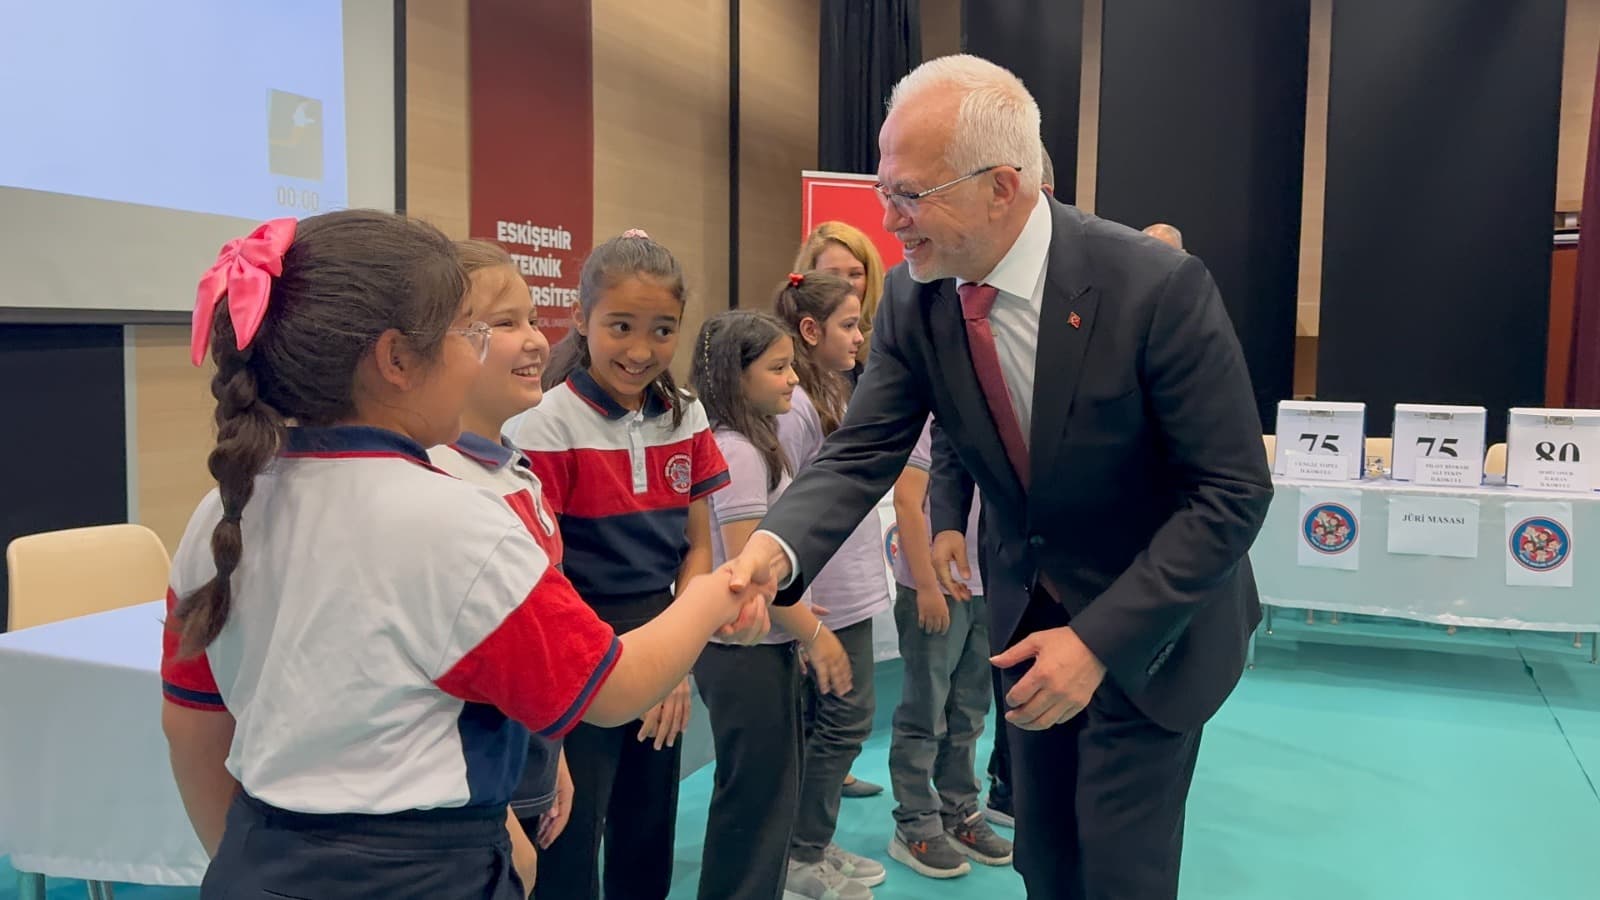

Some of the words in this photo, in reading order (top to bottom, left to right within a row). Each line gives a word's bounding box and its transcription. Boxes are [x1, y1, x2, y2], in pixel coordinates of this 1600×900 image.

[497, 220, 572, 252] ESKİŞEHİR
[511, 253, 562, 278] TEKNİK
[1299, 433, 1340, 452] 75
[1416, 437, 1458, 457] 75
[1402, 512, 1425, 523] JÜRİ
[1428, 515, 1465, 525] MASASI
